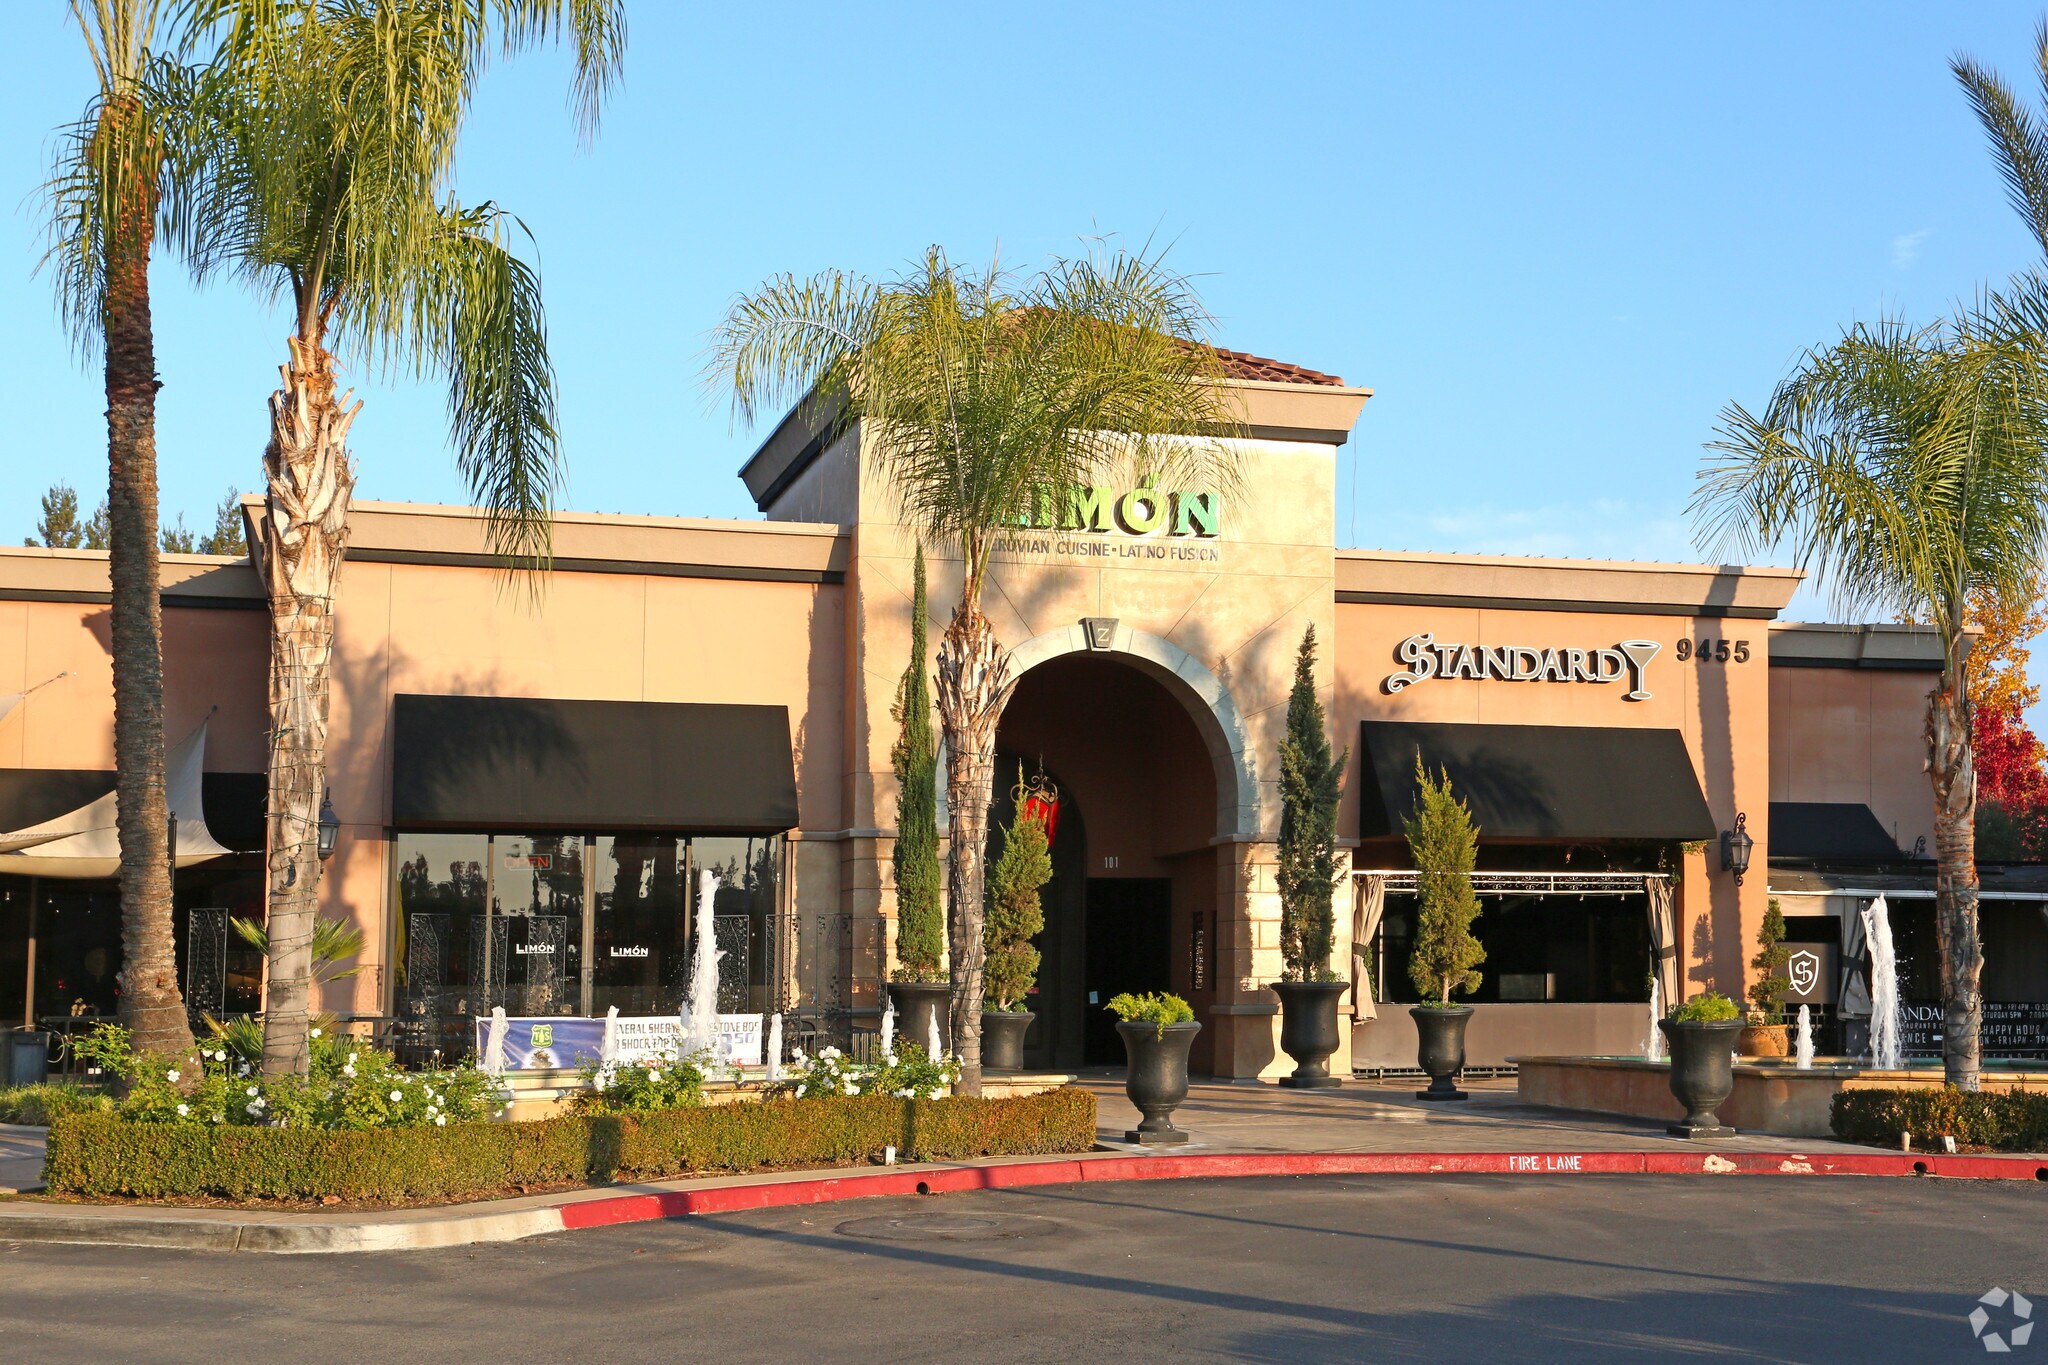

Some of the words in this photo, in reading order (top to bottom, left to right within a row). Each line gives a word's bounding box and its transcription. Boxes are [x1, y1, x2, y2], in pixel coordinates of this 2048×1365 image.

[998, 472, 1221, 534] IMÓN
[1057, 542, 1111, 557] CUISINE
[1119, 545, 1166, 559] LATNO
[1097, 627, 1110, 642] Z
[1675, 638, 1751, 664] 9455
[1386, 632, 1628, 693] STANDARD
[504, 855, 550, 869] OPEN
[1104, 856, 1119, 869] 101
[515, 941, 556, 954] LIMÓN
[610, 944, 649, 957] LIMÓN
[1983, 1011, 2008, 1019] ATURDAY
[615, 1023, 647, 1034] ENERAL
[1983, 1024, 2012, 1035] HAPPY
[2016, 1024, 2041, 1035] HOUR
[1979, 1035, 1990, 1045] ON
[1509, 1156, 1540, 1171] FIRE
[1546, 1156, 1582, 1171] LANE
